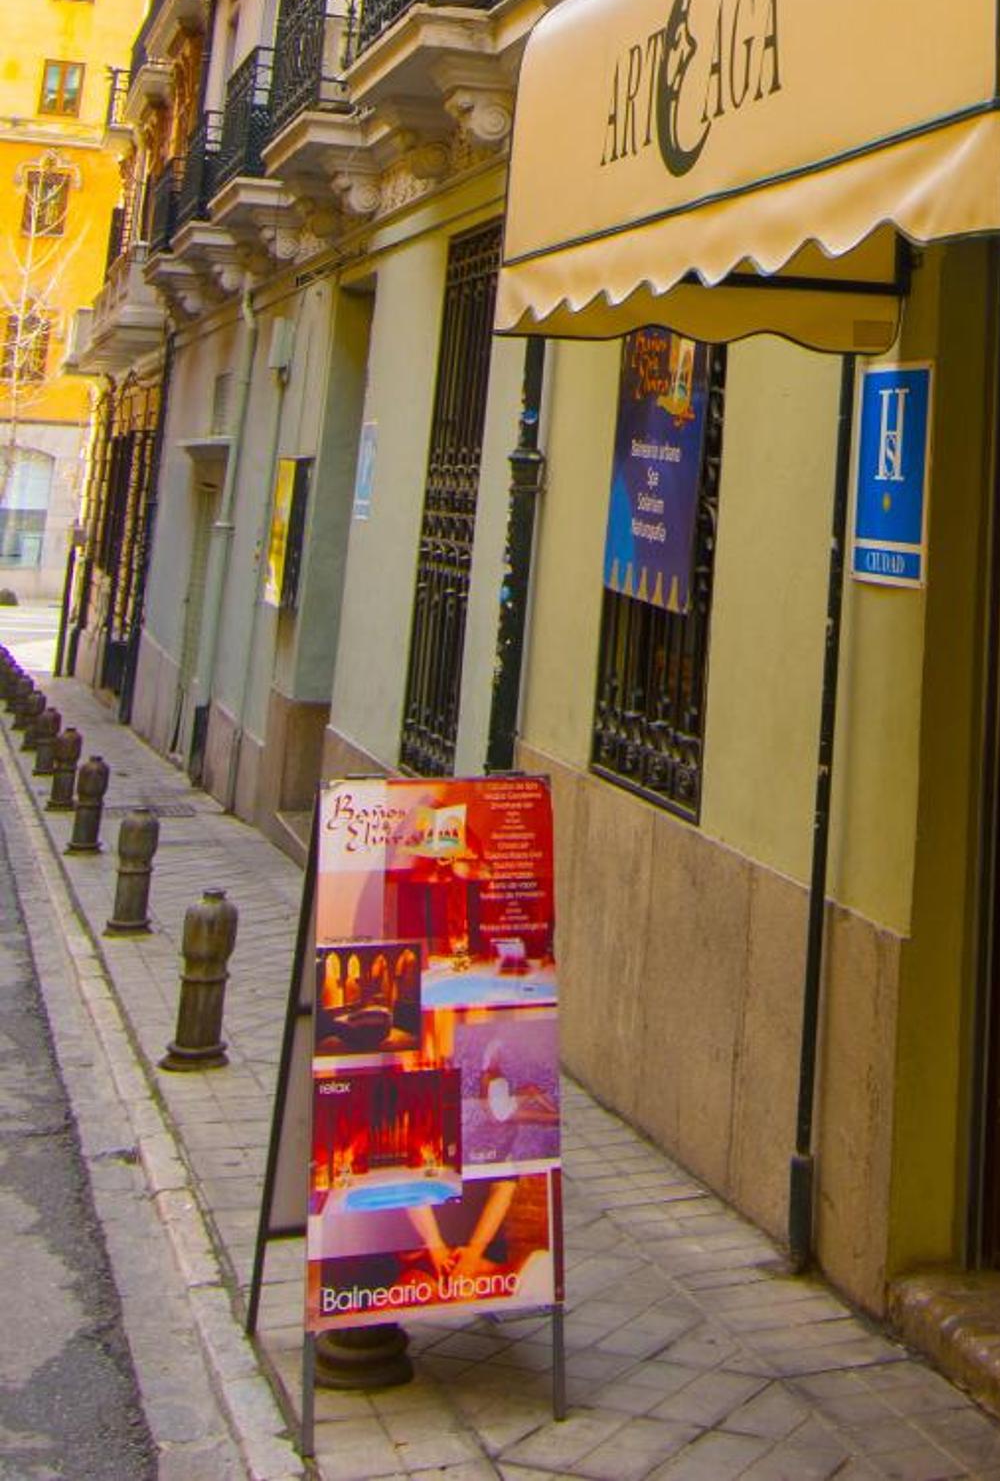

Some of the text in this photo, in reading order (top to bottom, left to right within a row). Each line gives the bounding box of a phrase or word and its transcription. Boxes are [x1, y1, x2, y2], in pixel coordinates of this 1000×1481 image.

[319, 1081, 351, 1095] relax
[323, 1273, 521, 1312] Balneario Urbano
